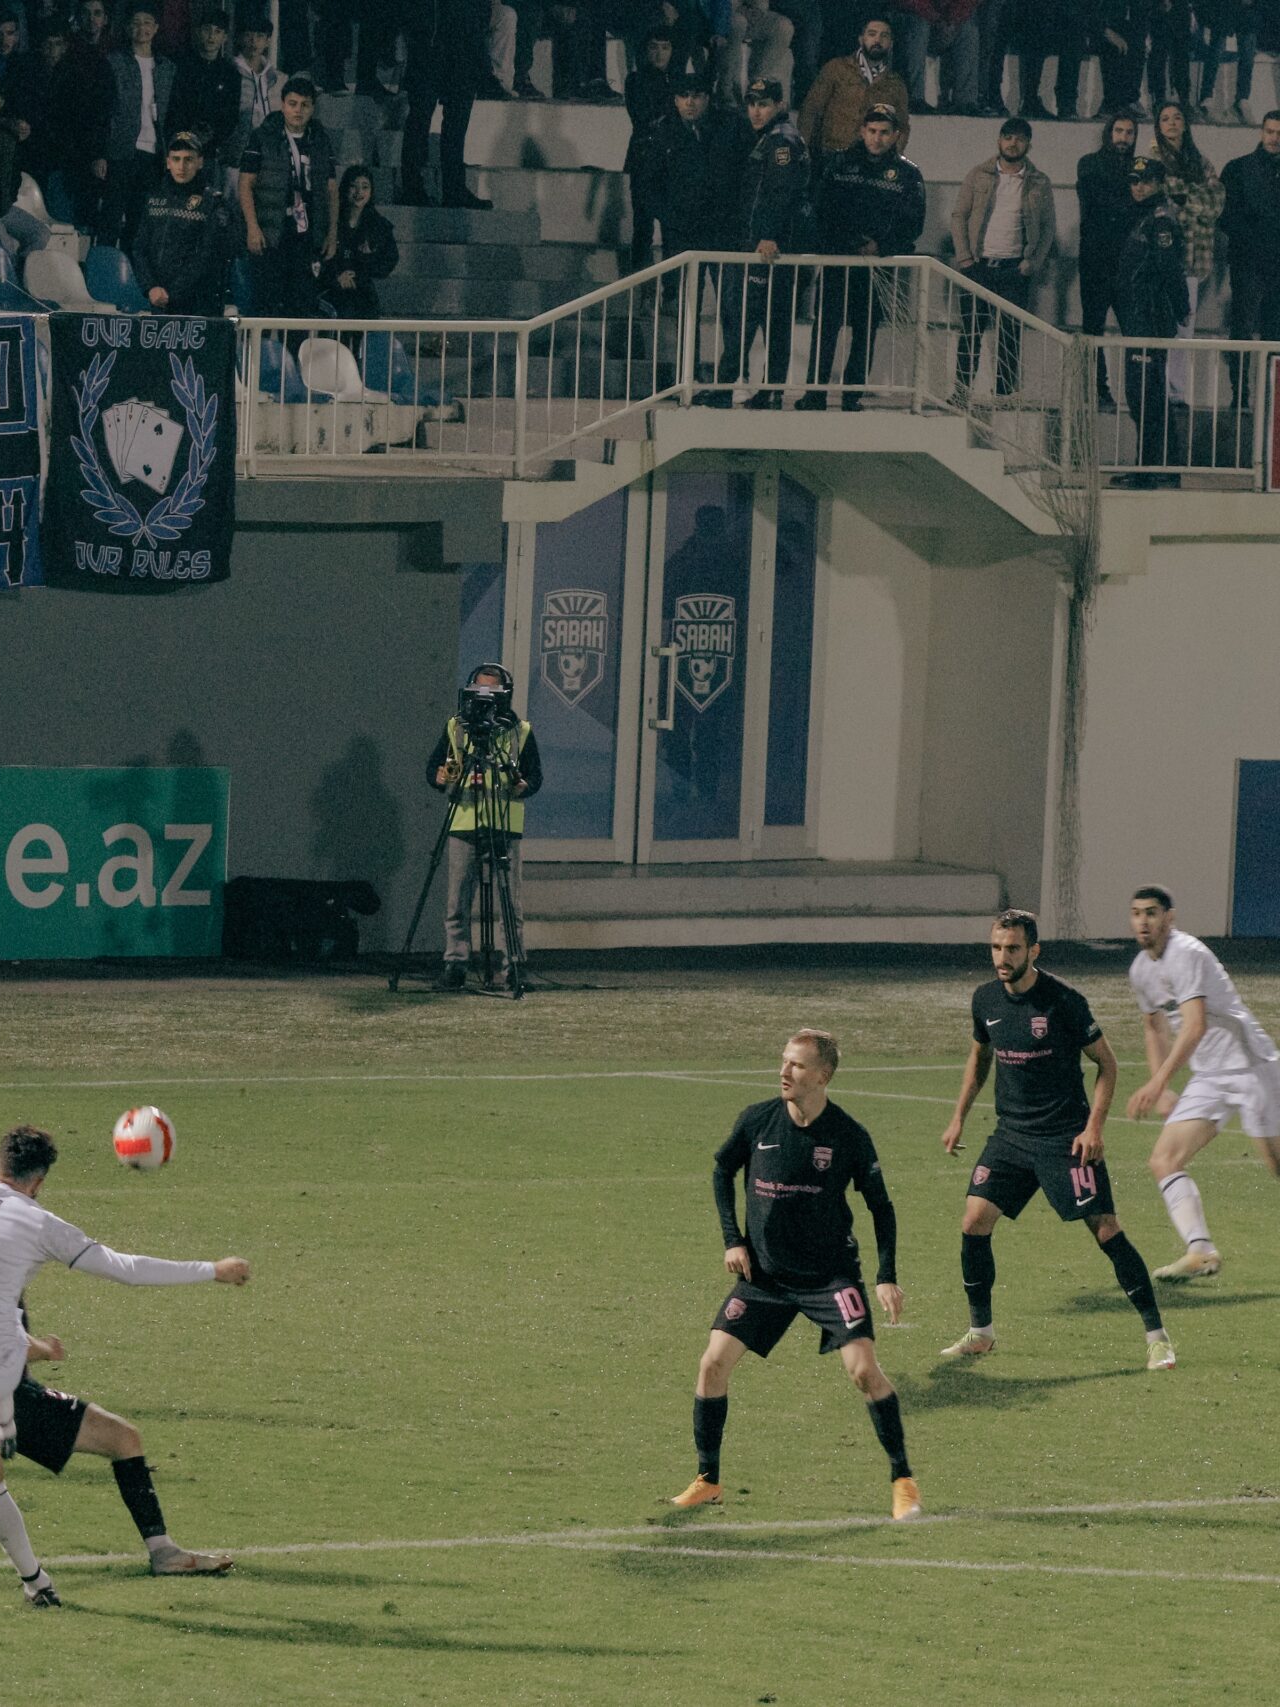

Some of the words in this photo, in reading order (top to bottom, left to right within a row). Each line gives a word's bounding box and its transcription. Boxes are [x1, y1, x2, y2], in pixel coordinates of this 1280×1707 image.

[81, 318, 132, 347] OUR
[140, 319, 206, 349] GAME
[129, 549, 211, 579] RULES
[544, 619, 604, 649] SABAH
[675, 624, 732, 654] SABAH
[1070, 1165, 1096, 1198] 14
[834, 1287, 866, 1323] 10
